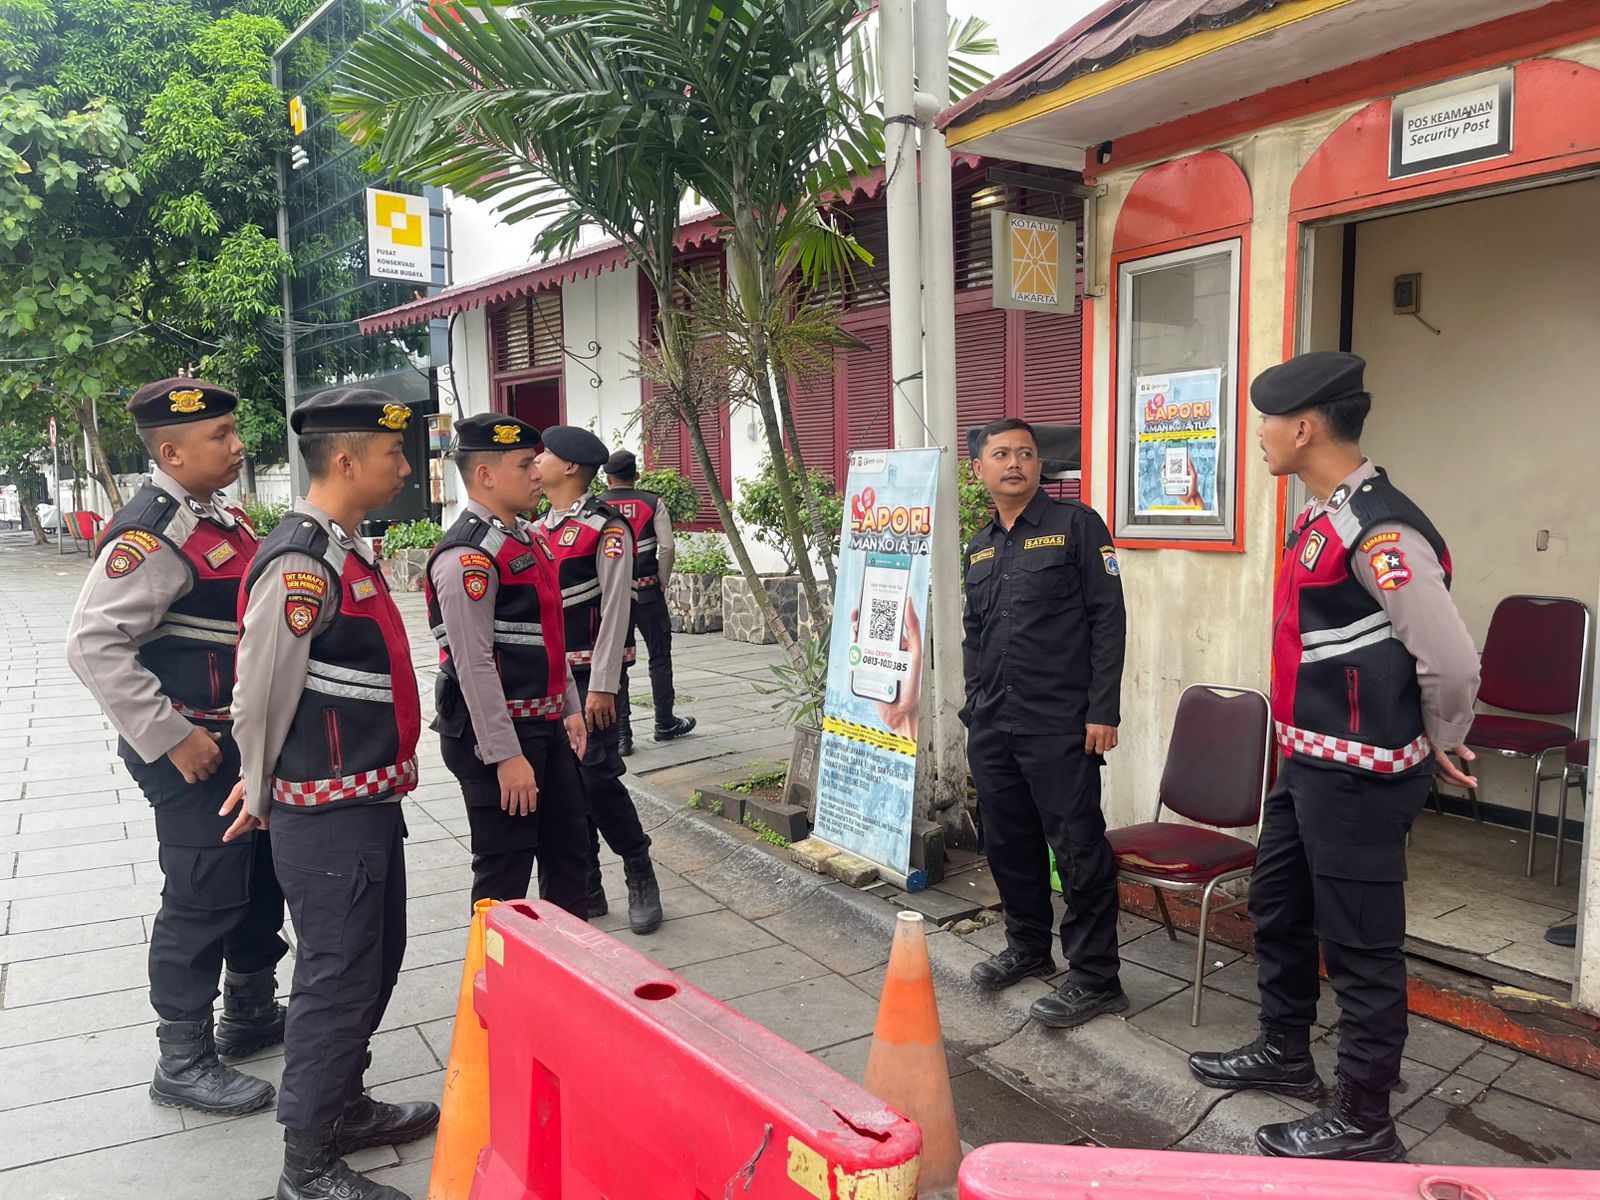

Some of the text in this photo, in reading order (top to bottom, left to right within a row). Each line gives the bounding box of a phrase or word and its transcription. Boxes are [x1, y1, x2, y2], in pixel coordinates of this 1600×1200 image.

[1407, 100, 1493, 130] POS KEAMANAN
[1409, 118, 1490, 146] Security Post
[1011, 219, 1057, 232] KOTA TUA
[376, 248, 397, 256] PUSAT
[377, 258, 415, 267] KONSERVASI
[377, 267, 424, 278] CAGAR BUDAYA
[850, 537, 877, 550] MAN
[1026, 536, 1063, 547] SATGAS
